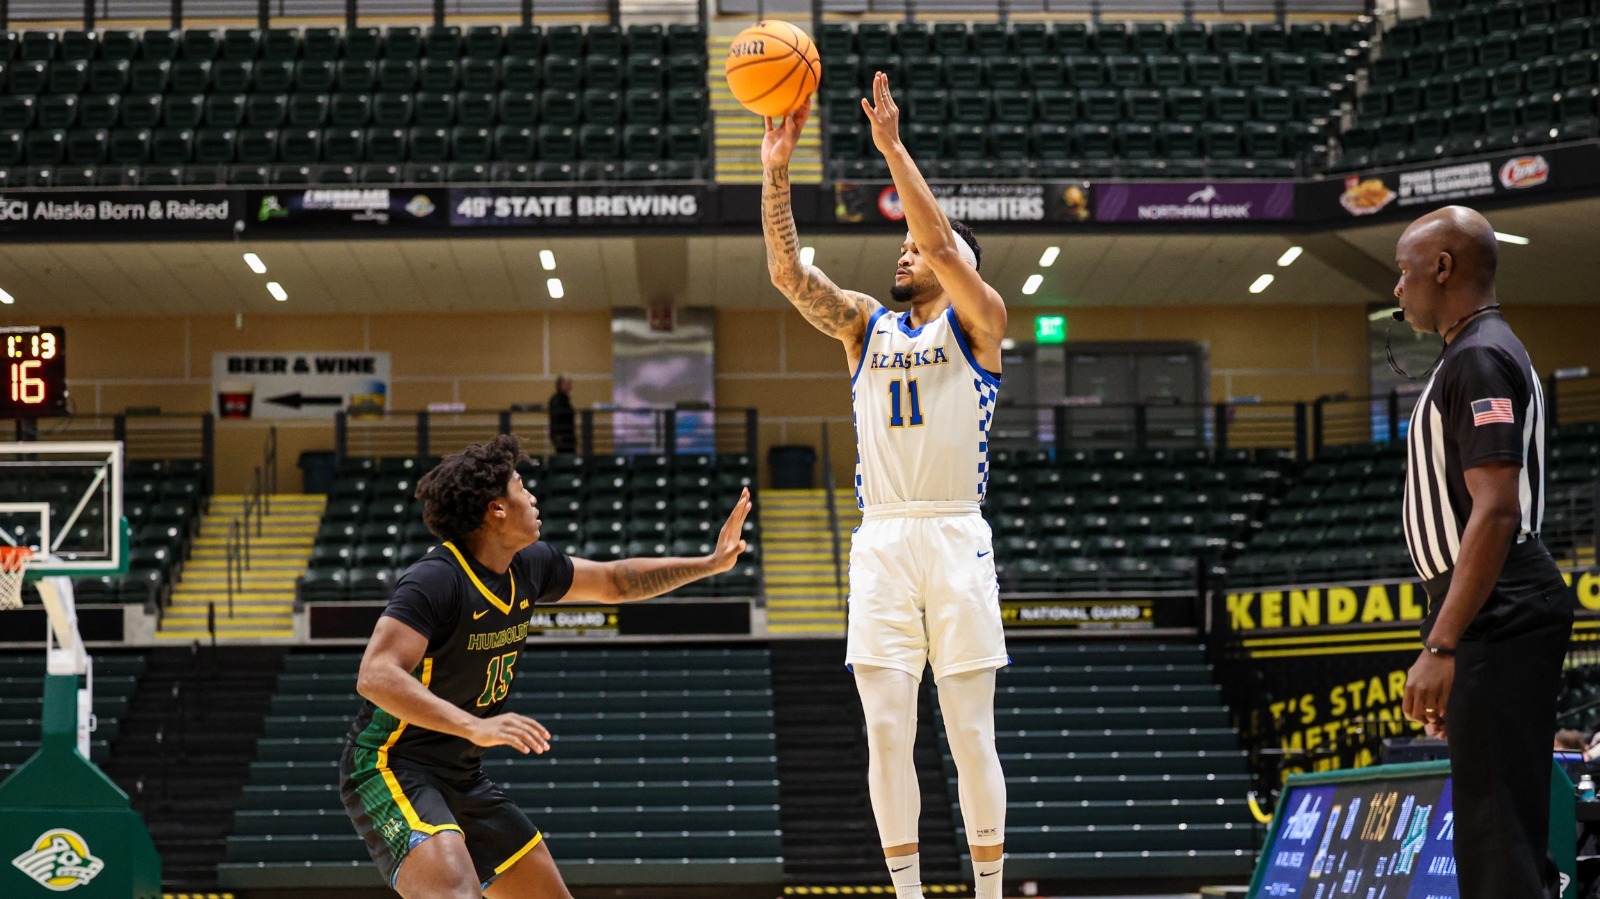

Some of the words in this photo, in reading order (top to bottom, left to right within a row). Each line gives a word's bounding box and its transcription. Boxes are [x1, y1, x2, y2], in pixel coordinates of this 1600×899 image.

[33, 201, 96, 220] Alaska
[99, 201, 145, 220] Born
[148, 200, 163, 220] &
[166, 199, 229, 220] Raised
[494, 196, 572, 217] STATE
[577, 195, 697, 217] BREWING
[1137, 204, 1210, 219] NORTHRIM
[1211, 203, 1251, 219] BANK
[228, 356, 287, 374] BEER
[293, 357, 309, 373] &
[315, 357, 375, 374] WINE
[870, 346, 950, 371] ALASKA
[11, 360, 45, 404] 16
[888, 377, 925, 428] 11
[1020, 606, 1090, 620] NATIONAL
[1090, 605, 1140, 619] GUARD
[1226, 582, 1424, 631] KENDAL
[555, 612, 606, 627] GUARD
[467, 621, 529, 650] HUMBOLDT
[477, 651, 518, 707] 15
[1329, 670, 1407, 716] STAR
